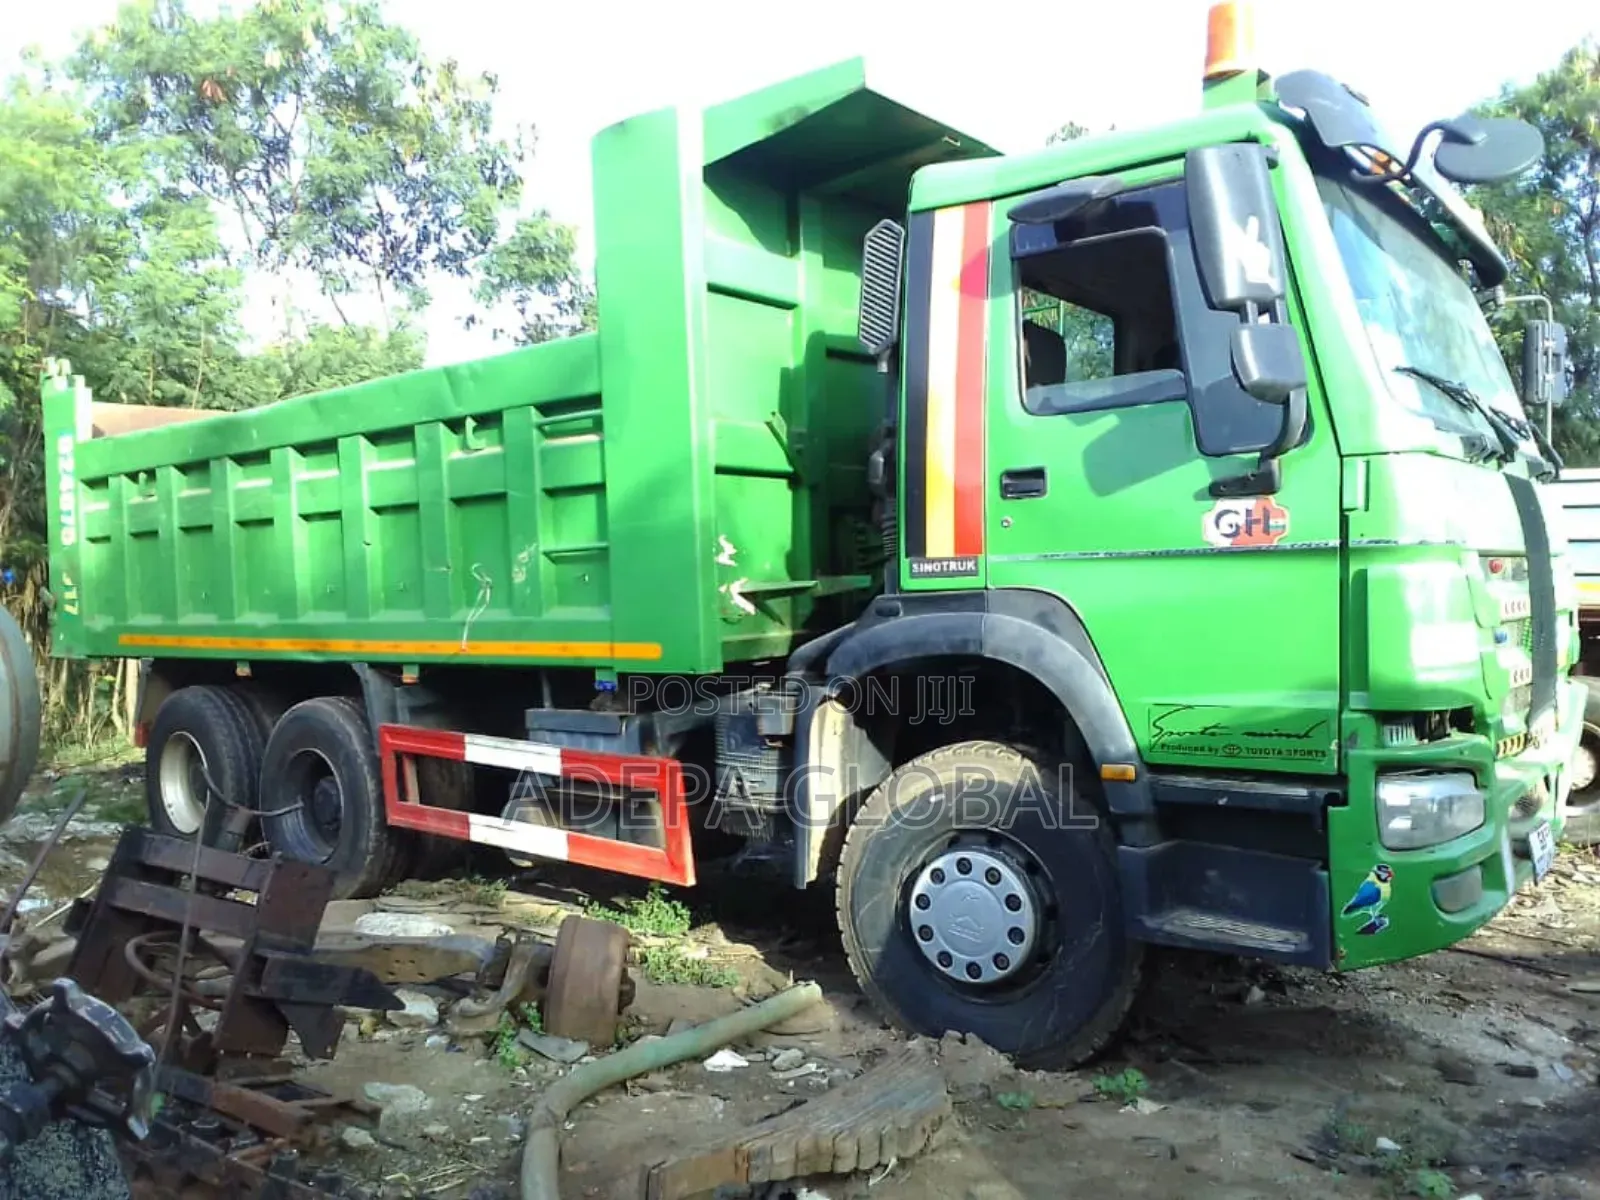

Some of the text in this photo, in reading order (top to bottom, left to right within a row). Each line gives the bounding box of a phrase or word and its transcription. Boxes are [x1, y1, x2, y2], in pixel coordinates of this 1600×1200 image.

[1214, 507, 1270, 538] GH
[911, 559, 977, 573] SINOTRUK
[1161, 743, 1205, 753] Produced
[1207, 745, 1219, 756] by
[1285, 749, 1328, 758] SPORTS
